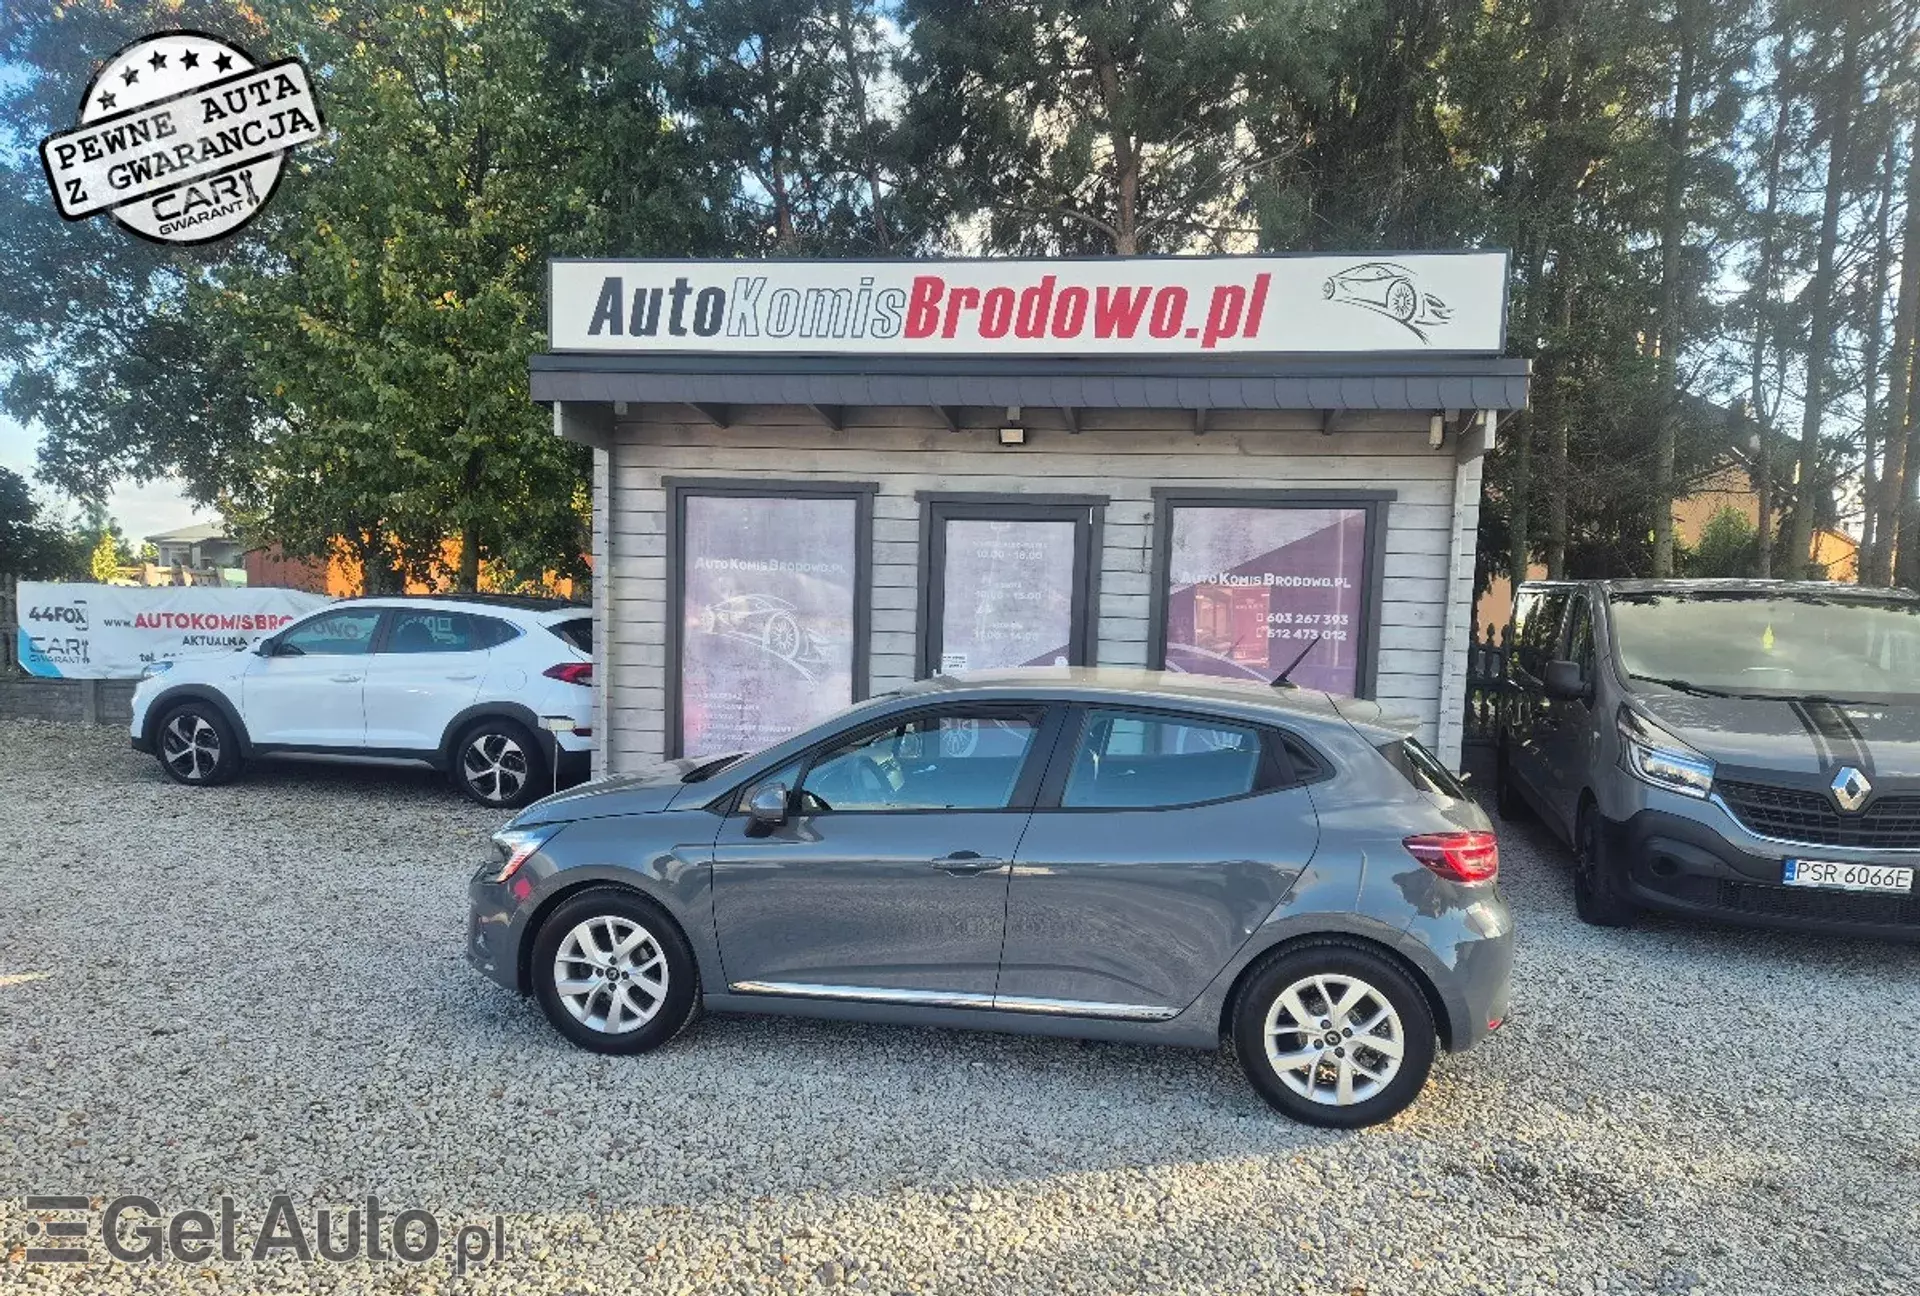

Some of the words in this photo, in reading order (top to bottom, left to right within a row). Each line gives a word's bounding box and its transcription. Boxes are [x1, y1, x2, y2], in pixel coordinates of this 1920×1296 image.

[587, 273, 1271, 348] AutoKomisBrodowo.pl
[1267, 613, 1292, 624] 603
[1295, 613, 1320, 624] 267
[1323, 614, 1349, 625] 393
[1293, 628, 1319, 640] 473
[1322, 630, 1347, 641] 012
[182, 636, 248, 647] AKTUALNA
[1797, 862, 1838, 882] PSR
[1844, 867, 1910, 888] 6066E
